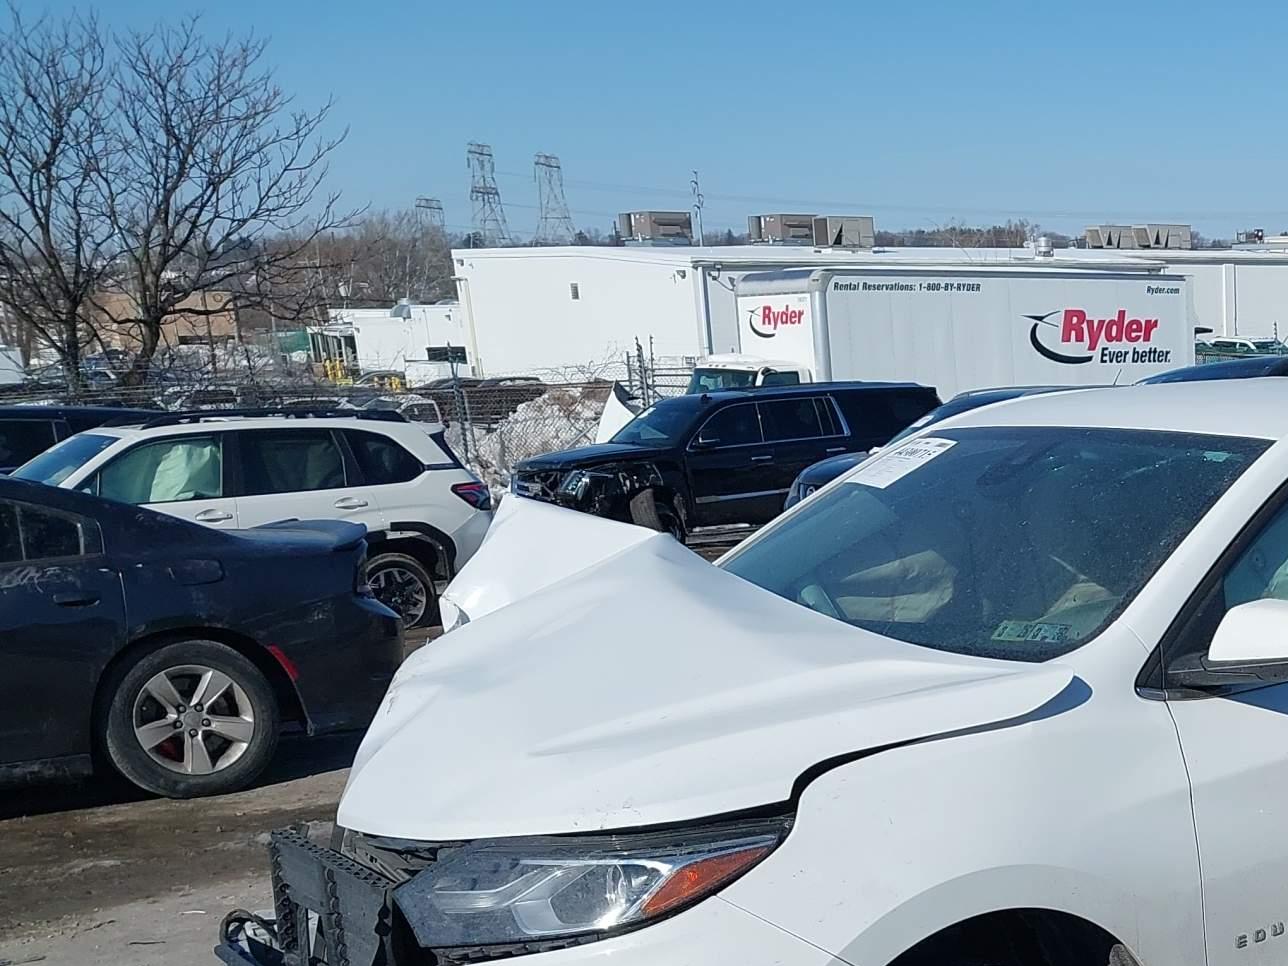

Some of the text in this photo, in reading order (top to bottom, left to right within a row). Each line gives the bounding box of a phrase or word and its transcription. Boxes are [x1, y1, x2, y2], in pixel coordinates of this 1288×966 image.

[833, 282, 982, 293] Rental Reservations: 1-800-BY-RYDER
[1146, 285, 1180, 296] Ryder.com
[762, 305, 805, 331] Ryder
[1061, 309, 1159, 352] Ryder
[1100, 347, 1172, 364] Ever better.
